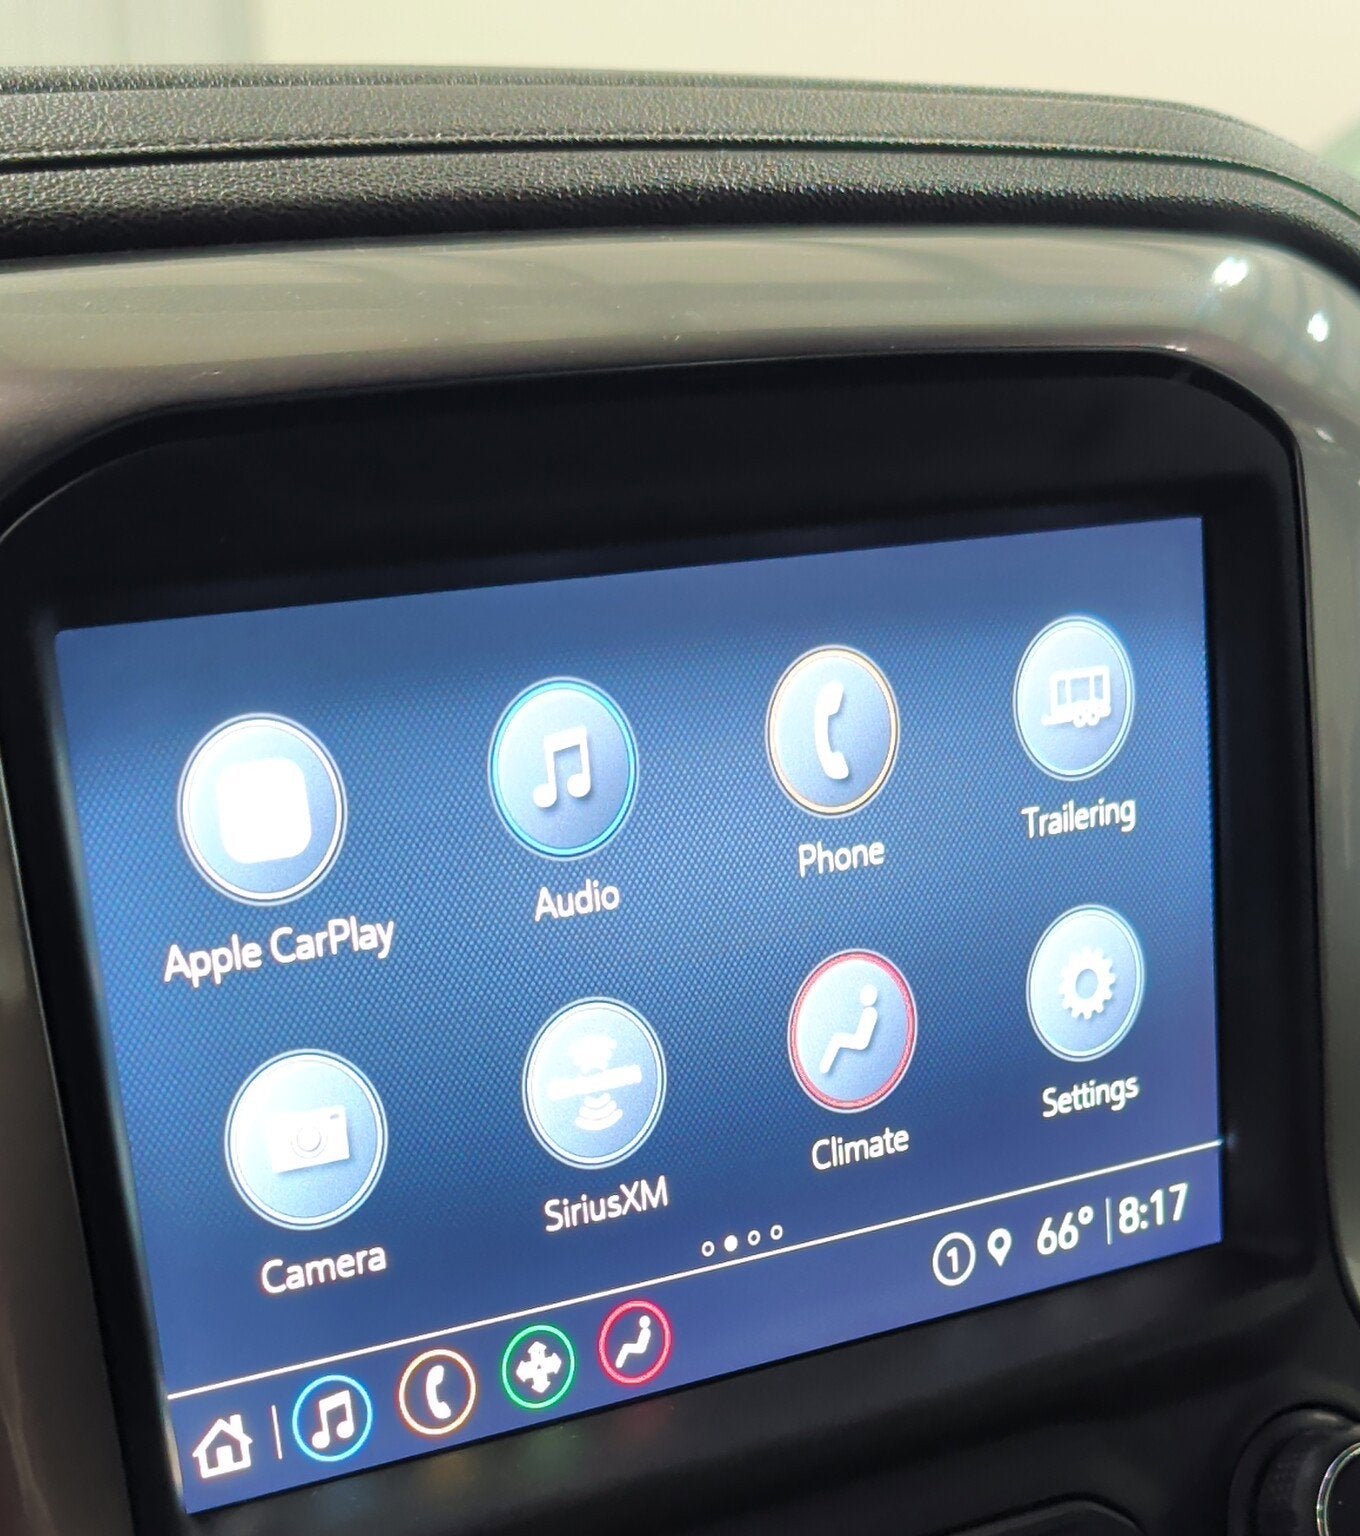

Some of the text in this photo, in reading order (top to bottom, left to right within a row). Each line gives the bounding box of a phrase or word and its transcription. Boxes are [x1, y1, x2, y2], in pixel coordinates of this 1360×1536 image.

[1021, 797, 1137, 839] Trailering
[797, 840, 885, 877] Phone
[534, 877, 620, 922] Audio
[163, 916, 395, 988] Apple CarPlay
[1041, 1074, 1140, 1118] Settings
[811, 1127, 910, 1171] Climate
[543, 1175, 669, 1233] SiriusXM
[1118, 1182, 1188, 1235] 8:17
[260, 1245, 388, 1295] Camera
